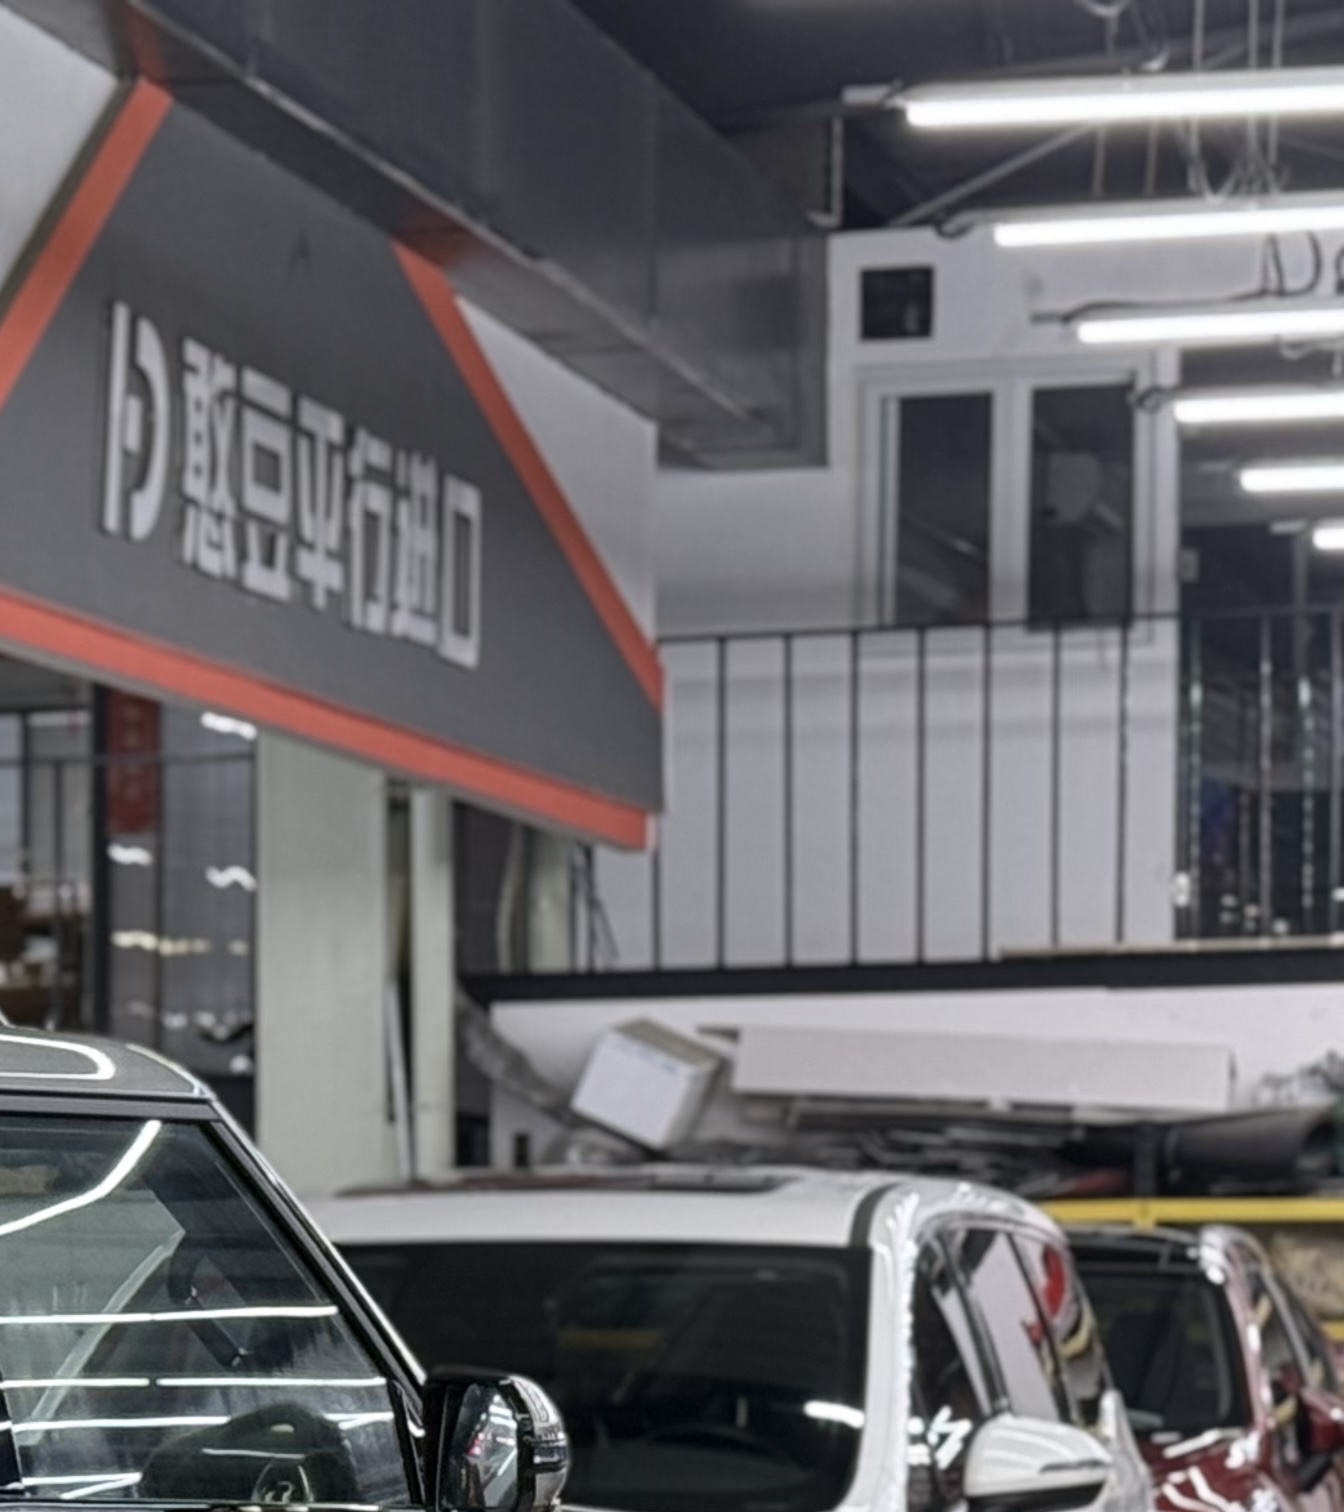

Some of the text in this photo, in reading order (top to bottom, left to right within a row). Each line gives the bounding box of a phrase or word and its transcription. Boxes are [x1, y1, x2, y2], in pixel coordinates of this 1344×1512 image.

[183, 336, 481, 669] 憨豆平行进口
